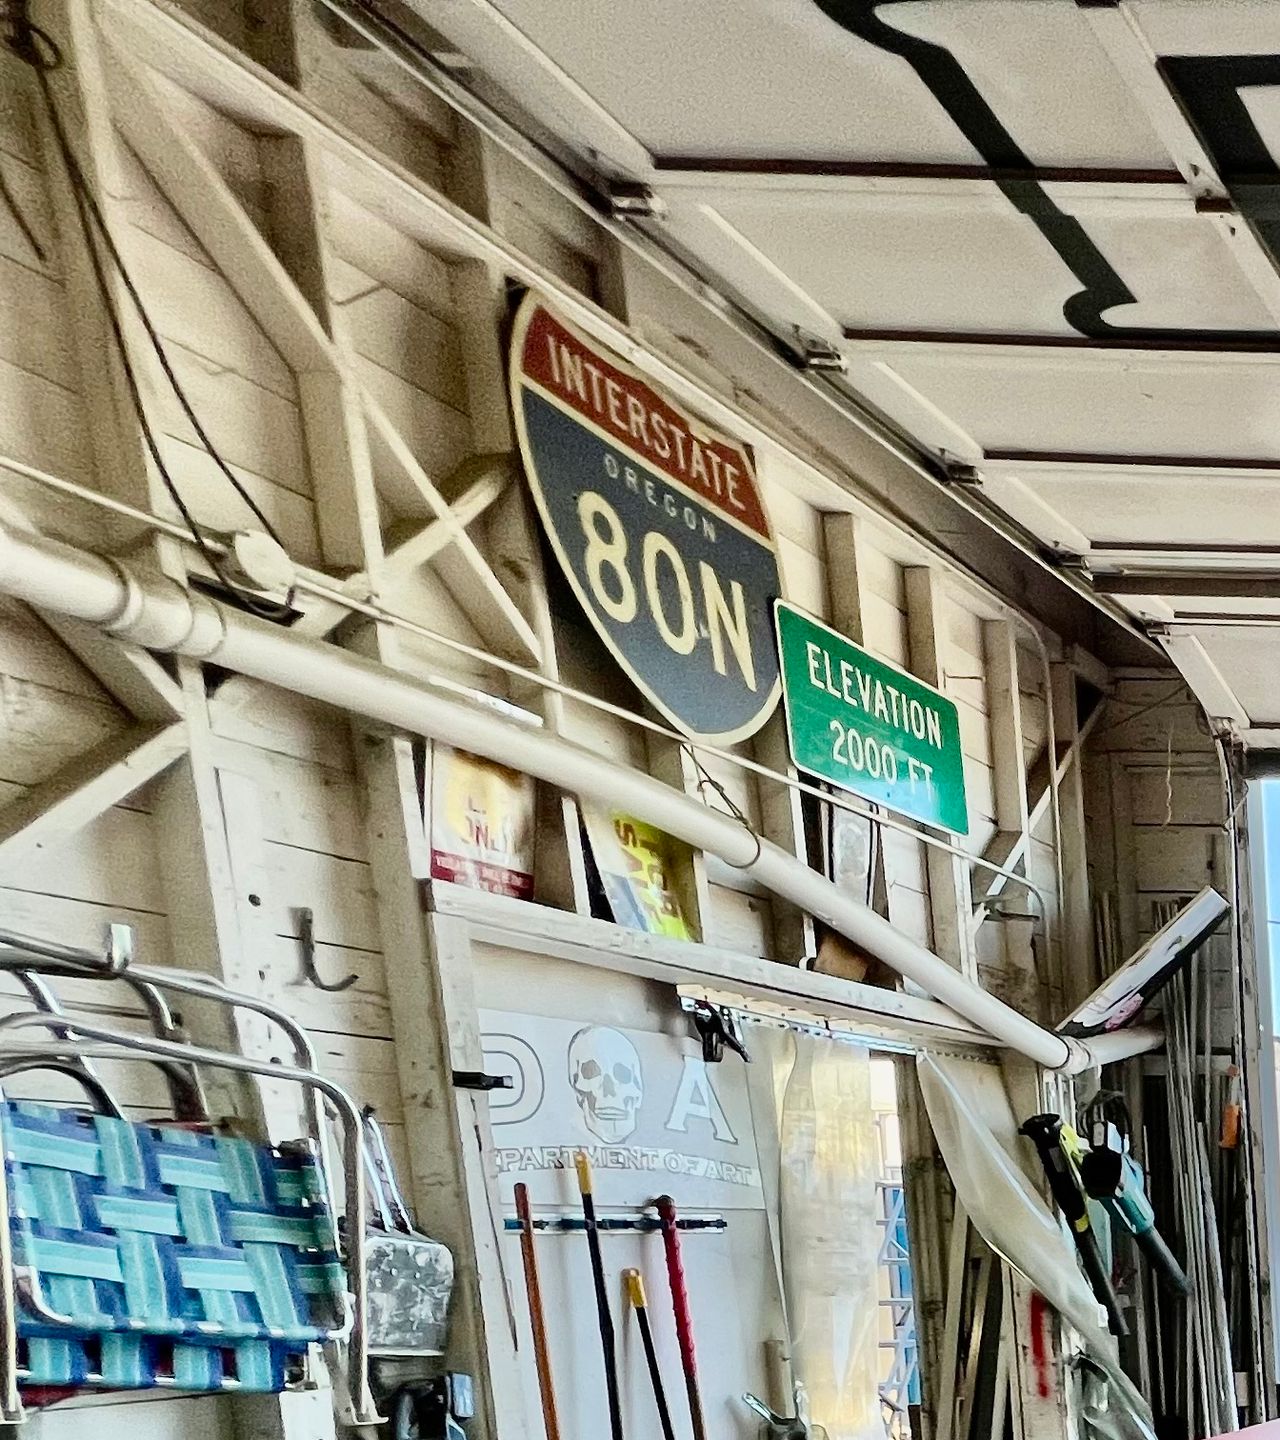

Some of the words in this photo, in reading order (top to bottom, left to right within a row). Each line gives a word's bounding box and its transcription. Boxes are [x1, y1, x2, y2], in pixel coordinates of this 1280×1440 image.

[547, 334, 746, 511] INTERSTATE
[604, 453, 717, 543] OREGON
[577, 490, 757, 693] 80N
[806, 640, 942, 750] ELEVATION
[829, 719, 898, 785] 2000
[908, 757, 933, 803] FT
[663, 1151, 699, 1177] OF
[703, 1159, 752, 1187] ART
